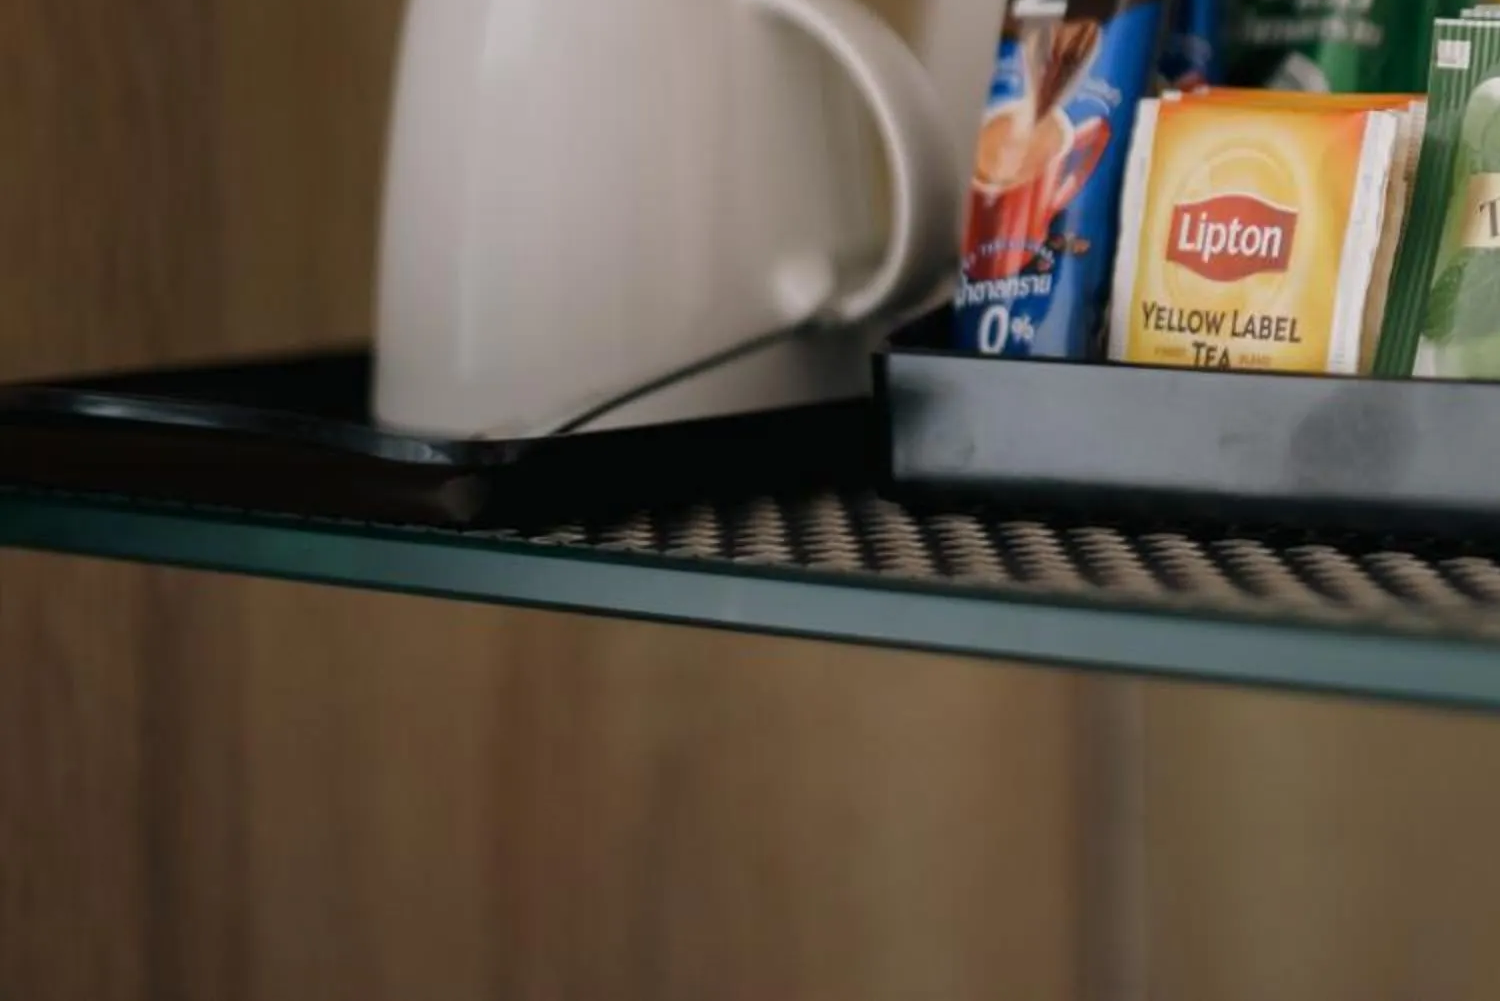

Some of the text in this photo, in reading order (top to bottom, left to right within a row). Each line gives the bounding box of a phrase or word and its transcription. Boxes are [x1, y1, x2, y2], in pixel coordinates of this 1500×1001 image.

[1177, 212, 1283, 264] Lipton
[978, 304, 1035, 356] 0%
[1141, 300, 1303, 344] YELLOW LABEL
[1192, 340, 1232, 370] TEA
